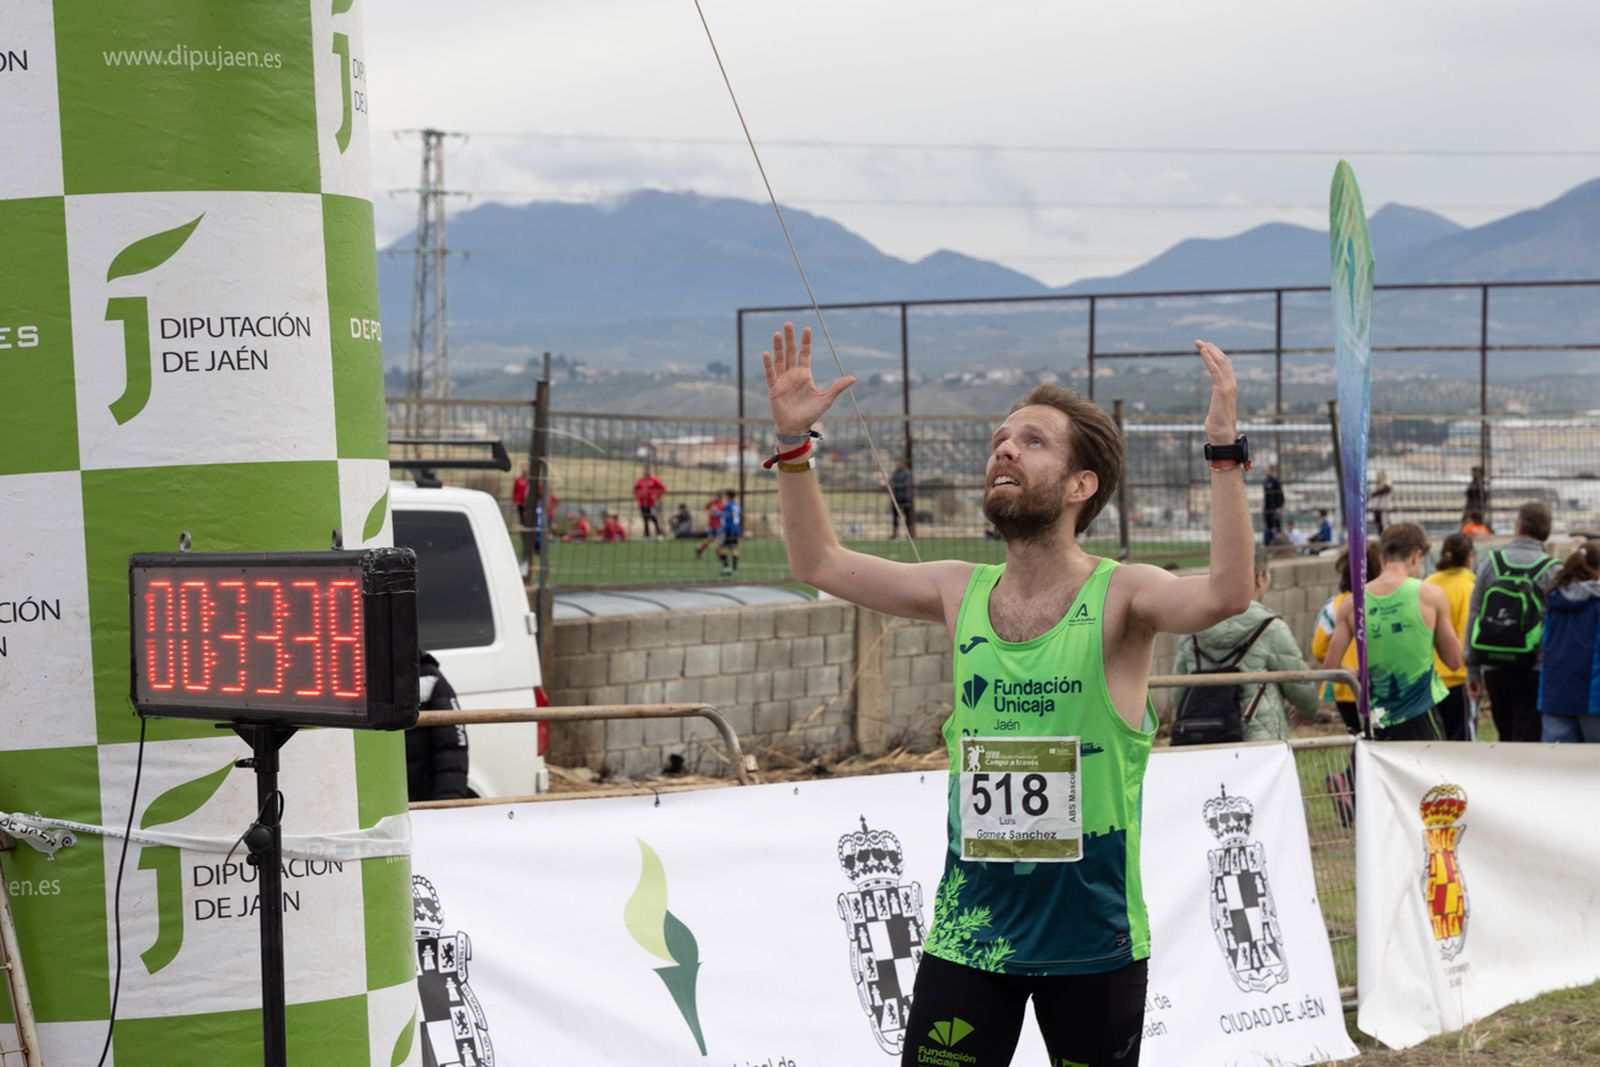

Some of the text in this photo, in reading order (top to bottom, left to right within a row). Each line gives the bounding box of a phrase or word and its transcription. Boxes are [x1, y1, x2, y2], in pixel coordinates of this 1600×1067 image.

[103, 43, 282, 71] www.dipujaen.es
[160, 312, 311, 339] DIPUTACIÓN
[162, 345, 268, 373] DE JAÉN
[145, 580, 362, 697] 00:33:38
[994, 676, 1082, 695] Fundación
[994, 696, 1055, 717] Unicaja
[994, 719, 1021, 731] Jaén
[985, 759, 1009, 768] Campo
[972, 772, 1049, 816] 518
[999, 816, 1016, 825] Luis
[1069, 803, 1077, 823] ABS
[1008, 829, 1057, 840] Sanchez
[195, 890, 300, 920] DE JAN
[1153, 993, 1172, 1010] de
[1220, 1008, 1272, 1034] CIUDAD
[1272, 1002, 1294, 1024] DE
[918, 1045, 977, 1064] Fundación
